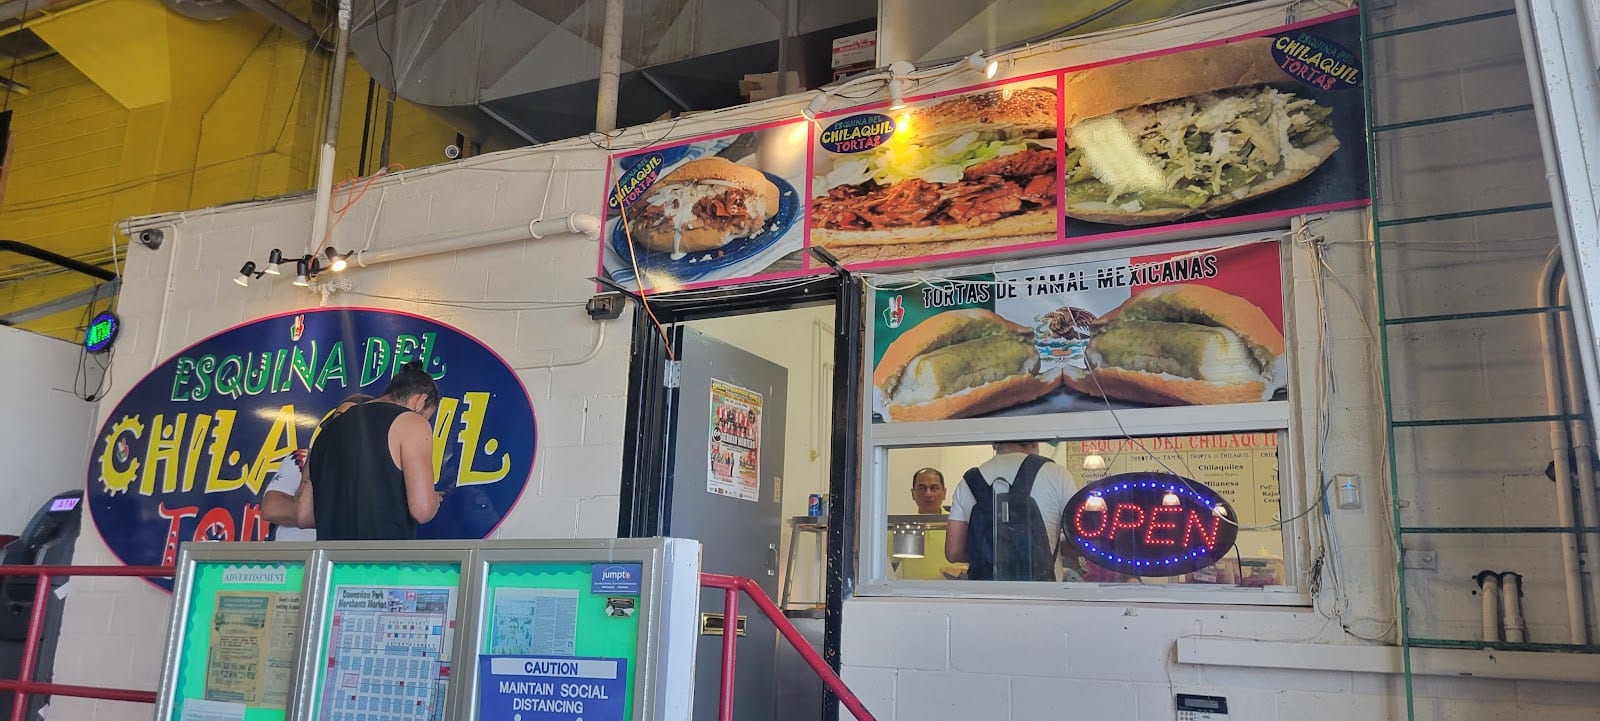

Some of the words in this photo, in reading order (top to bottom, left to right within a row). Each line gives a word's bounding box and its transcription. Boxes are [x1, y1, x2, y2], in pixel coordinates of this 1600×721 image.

[1276, 36, 1359, 84] CHILAQUIL
[1281, 55, 1337, 90] TORTAS
[822, 121, 894, 144] CHILAQUIL
[835, 135, 881, 152] TORTAS
[610, 156, 662, 208] CHILAQUIL
[623, 171, 658, 205] TORTAS
[922, 283, 990, 308] TORTAS
[996, 281, 1018, 300] DE
[1025, 270, 1090, 297] TAMAL
[1096, 255, 1219, 290] MEXICANAS
[171, 339, 348, 402] ESQUINA
[359, 331, 447, 388] DEL
[98, 391, 512, 497] CHILAIL
[1153, 436, 1184, 450] DEL
[1198, 464, 1243, 472] Chilaquiles
[57, 500, 76, 509] ATM
[1073, 503, 1221, 550] OPEN
[224, 572, 285, 583] ADVERTISEMENT
[524, 661, 579, 676] CAUTION
[499, 681, 554, 696] MAINTAIN
[559, 683, 609, 700] SOCIAL
[512, 697, 584, 714] DISTANCING
